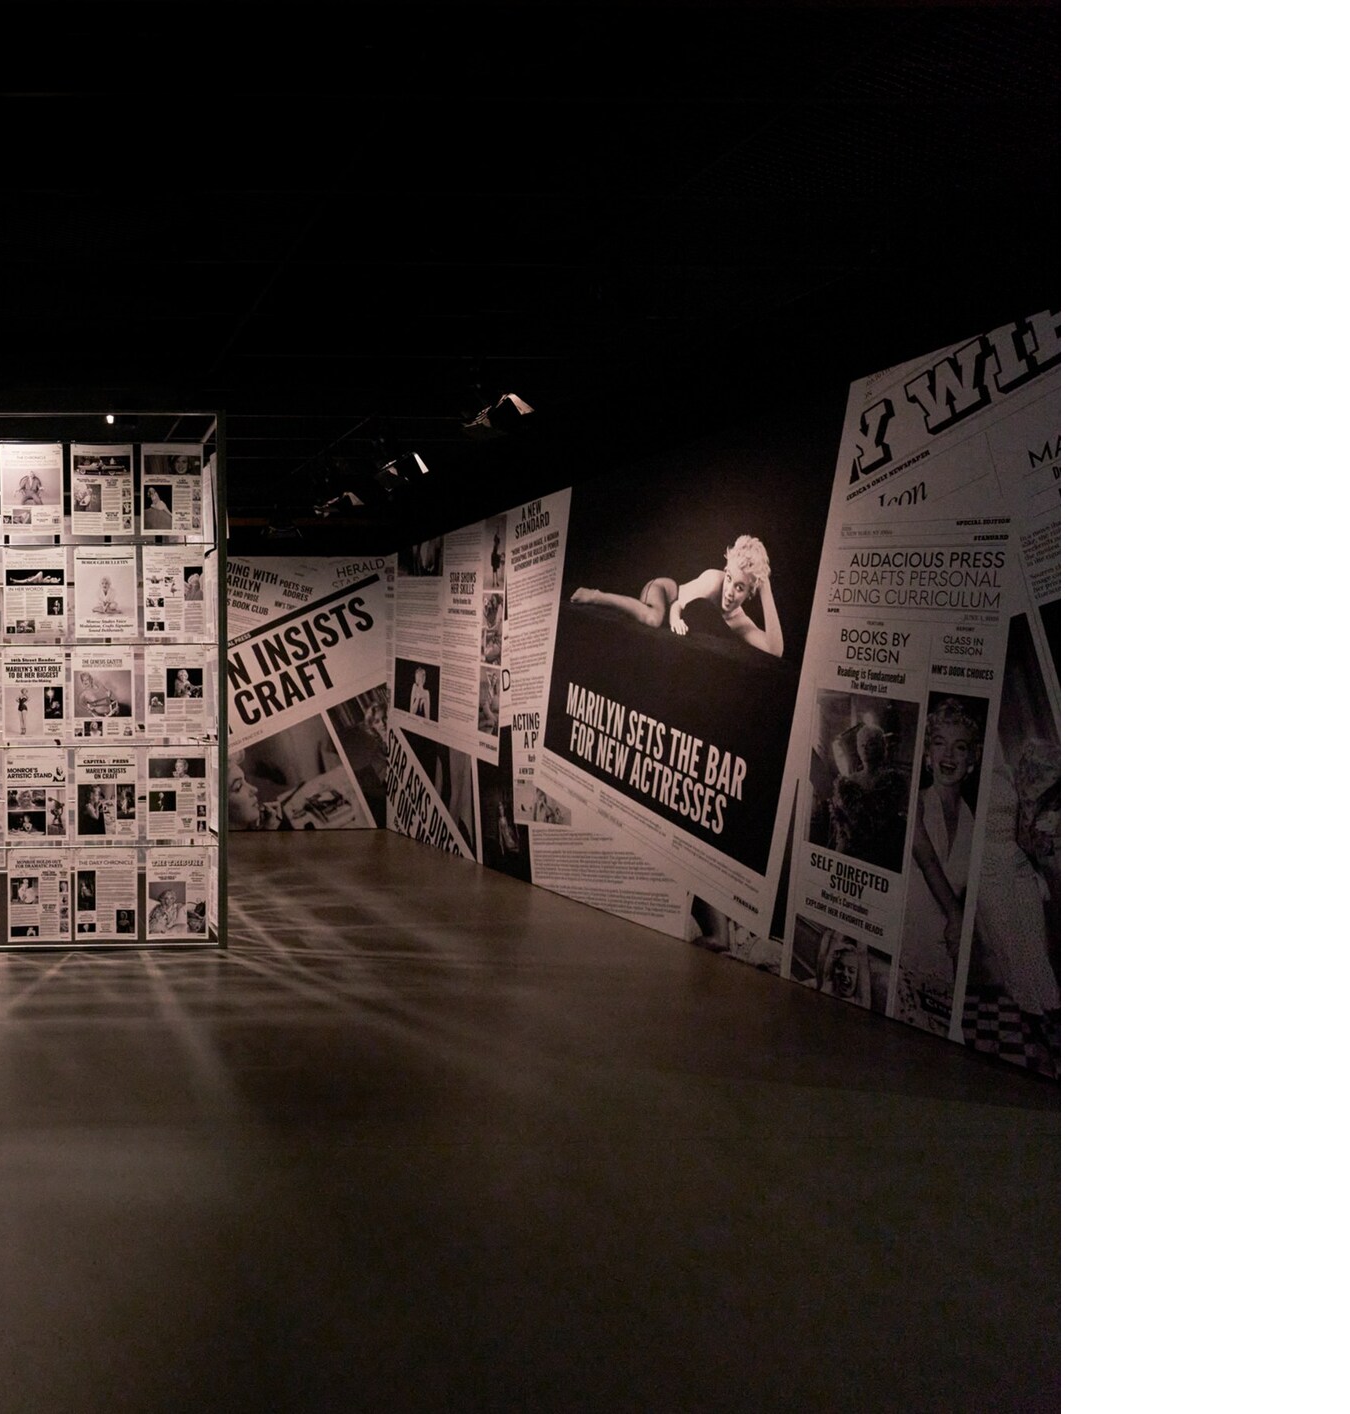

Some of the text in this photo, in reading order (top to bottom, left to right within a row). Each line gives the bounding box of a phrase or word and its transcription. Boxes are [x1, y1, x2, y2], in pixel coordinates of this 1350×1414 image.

[522, 499, 541, 521] A NEW
[515, 511, 550, 540] STANDARD
[956, 518, 983, 526] SPECIAL
[336, 559, 385, 578] HERALD
[850, 551, 1005, 568] AUDACIOUS PRESS
[253, 568, 278, 585] WITH
[450, 572, 476, 583] STAR SHOWS
[850, 571, 904, 587] DRAFTS
[909, 570, 1002, 588] PERSONAL
[279, 579, 313, 595] POETS SHE
[282, 589, 308, 601] ADORES
[460, 583, 474, 595] SKILLS
[232, 600, 269, 616] BOOK CLUB
[885, 590, 1000, 609] CURRICULUM
[251, 597, 373, 677] INSISTS
[840, 629, 911, 647] BOOKS BY
[943, 635, 984, 646] CLASS IN
[846, 646, 900, 664] DESIGN
[944, 646, 983, 656] SESSION
[837, 666, 860, 681] Reading
[867, 669, 906, 684] Fundamental
[931, 664, 994, 681] MM'S BOOK CHOICES
[234, 654, 333, 725] CRAFT
[851, 680, 859, 689] The
[878, 685, 888, 694] List
[512, 712, 540, 731] ACTING
[566, 681, 748, 801] MARILYN SETS THE BAR
[386, 729, 407, 783] STAR
[405, 765, 431, 825] ASKS
[569, 719, 728, 835] FOR NEW ACTRESSES
[810, 852, 889, 893] SELF DIRECTED
[830, 874, 864, 899] STUDY
[733, 895, 759, 915] STANDARD
[806, 897, 884, 937] EXPLORE HER FAVORITE READS
